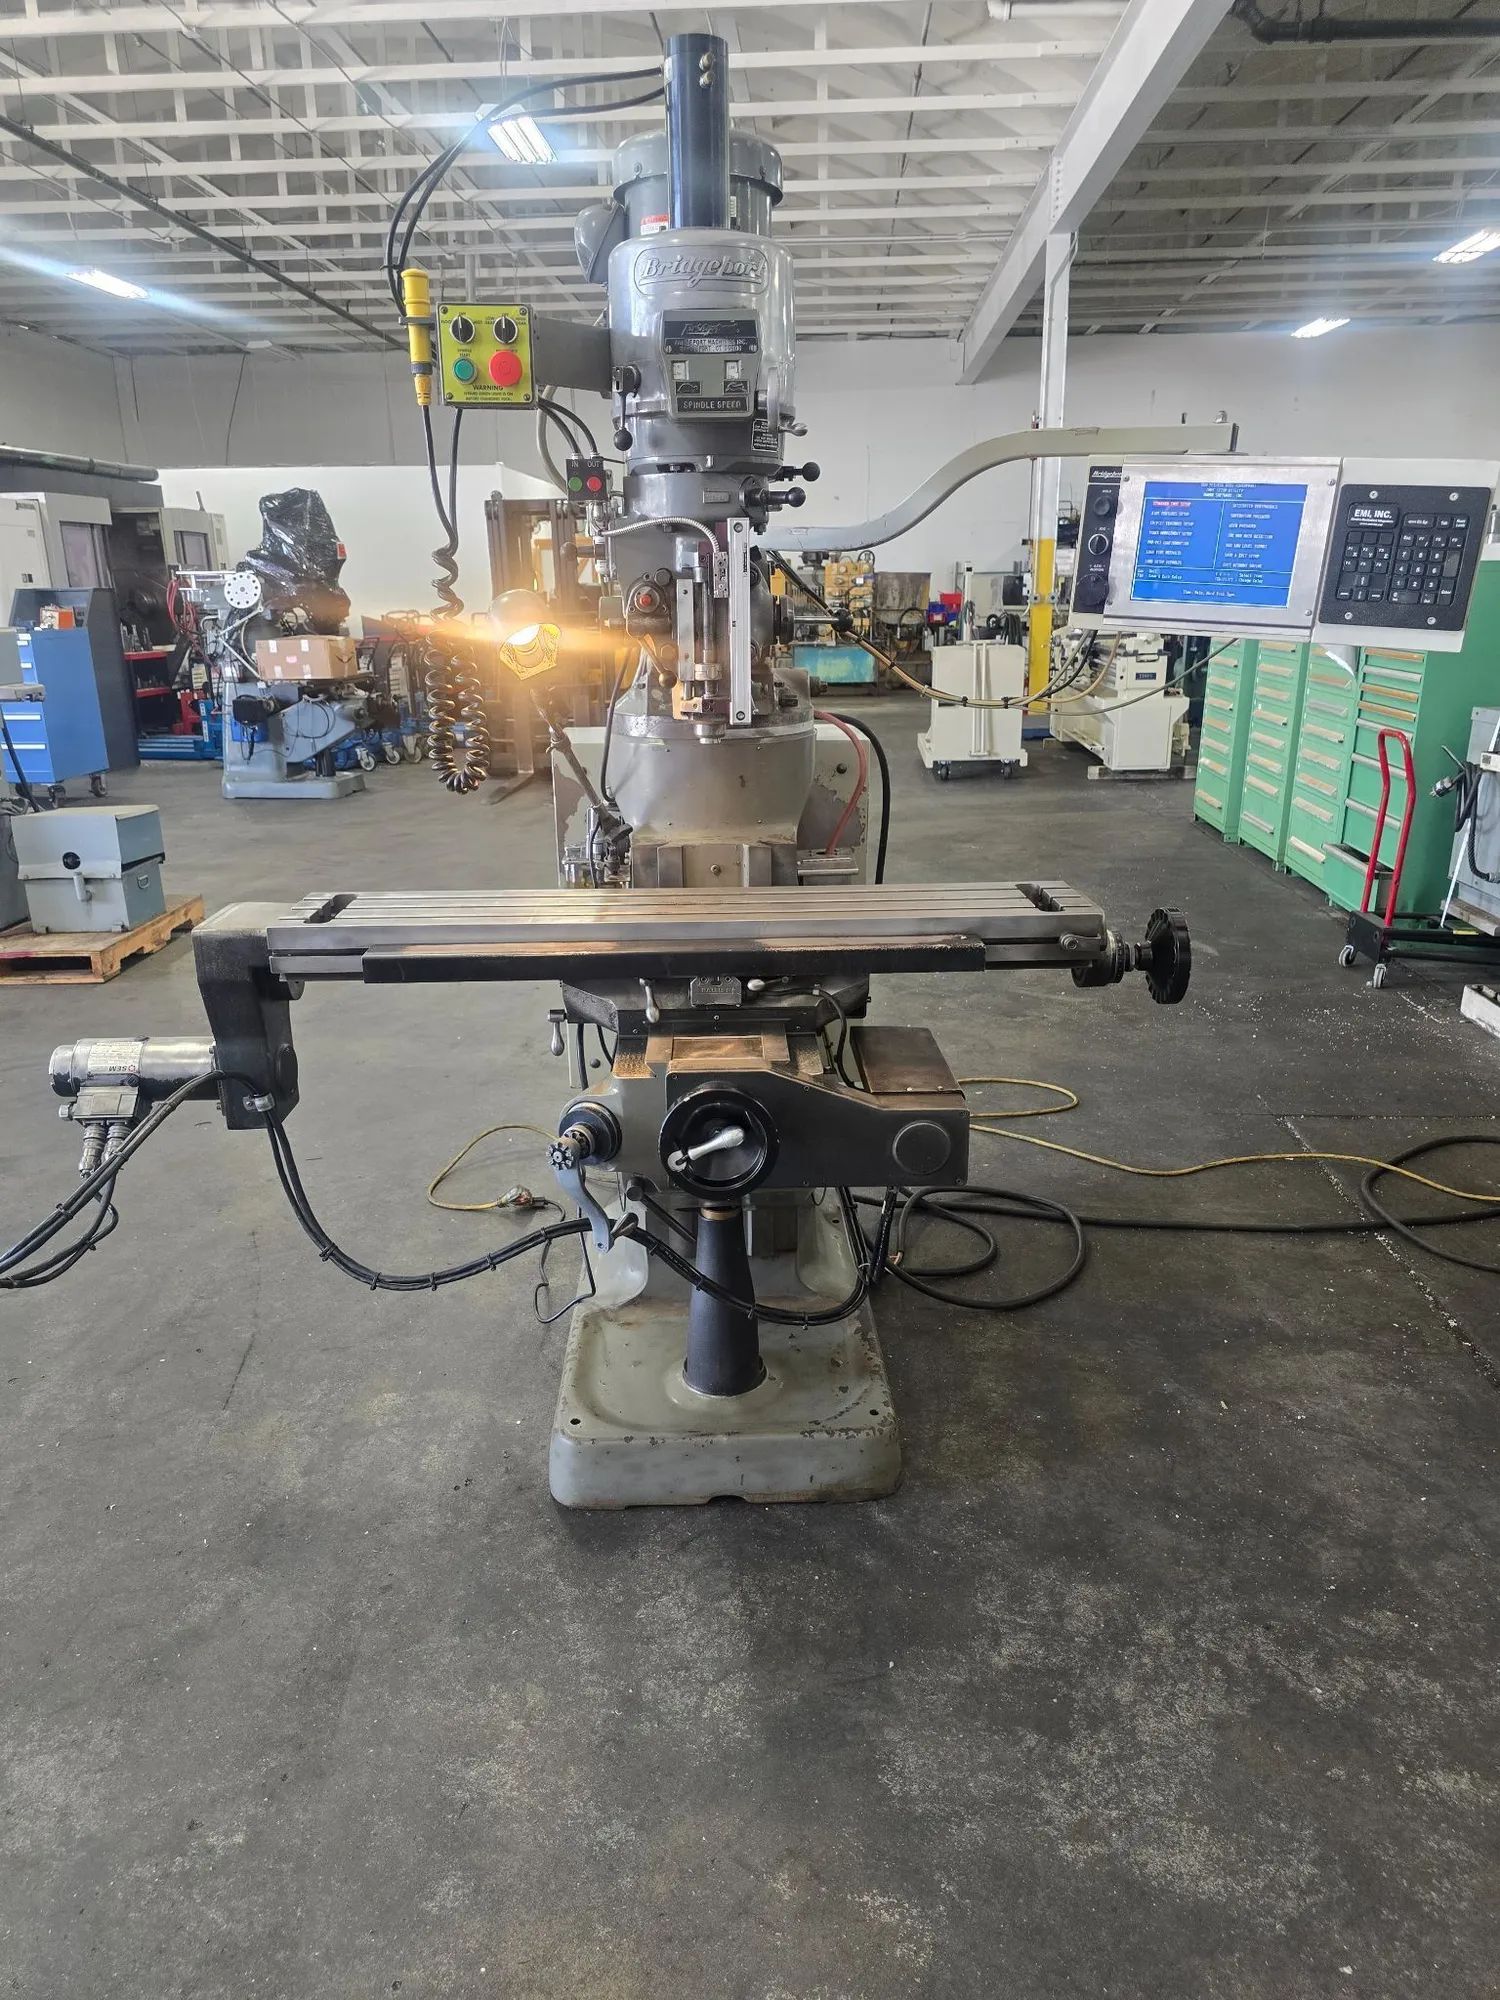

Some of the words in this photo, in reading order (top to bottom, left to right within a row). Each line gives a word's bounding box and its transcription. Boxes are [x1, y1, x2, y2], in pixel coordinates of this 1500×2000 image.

[641, 255, 766, 288] Bridgeport
[683, 401, 715, 409] SPINDLE
[717, 401, 741, 409] SPEED
[1354, 509, 1372, 518] EMI,
[1374, 510, 1392, 519] INC.
